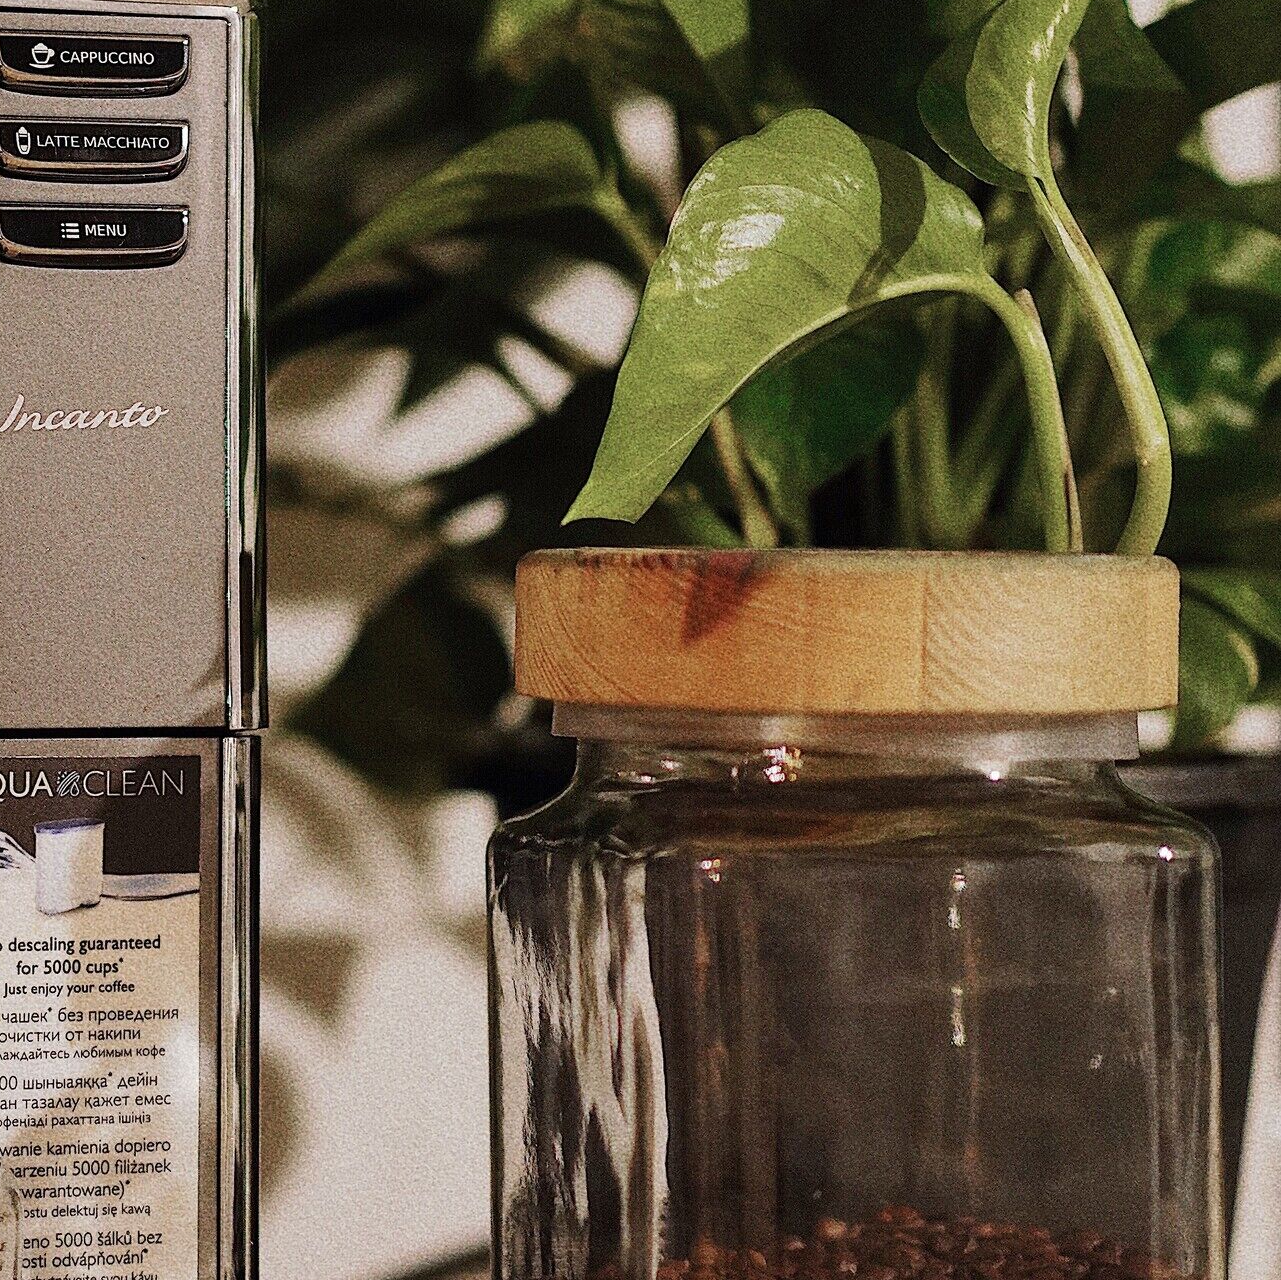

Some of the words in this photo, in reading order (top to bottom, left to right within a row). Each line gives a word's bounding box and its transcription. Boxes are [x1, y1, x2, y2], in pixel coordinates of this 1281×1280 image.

[60, 50, 155, 65] CAPPUCCINO
[36, 135, 79, 148] LATTE
[84, 136, 170, 149] MACCHIATO
[85, 224, 127, 237] MENU
[83, 770, 183, 797] CLEAN
[8, 937, 75, 955] descaling
[79, 935, 161, 954] guaranteed
[17, 961, 38, 974] for
[44, 960, 81, 974] 5000
[3, 983, 27, 998] Just
[31, 983, 63, 997] enjoy
[67, 983, 94, 996] your
[98, 981, 135, 992] coffee
[58, 1007, 83, 1022] без
[89, 1009, 178, 1026] проведения
[65, 1031, 83, 1041] от
[88, 1029, 141, 1040] накипи
[73, 1046, 132, 1058] любимым
[136, 1046, 165, 1059] кофе
[117, 1073, 158, 1088] дейін
[22, 1097, 79, 1111] тазалау
[84, 1096, 129, 1108] қажет
[135, 1093, 171, 1106] емес
[52, 1115, 115, 1128] рахаттана
[47, 1140, 109, 1155] kamienia
[115, 1139, 171, 1157] dopiero
[10, 1162, 67, 1178] arzeniu
[72, 1160, 109, 1175] 5000
[115, 1159, 172, 1174] filiżanek
[19, 1179, 131, 1199] warantowane)
[52, 1205, 98, 1218] delektuj
[102, 1204, 118, 1217] się
[121, 1203, 150, 1216] kawą
[55, 1233, 92, 1248] 5000
[98, 1231, 132, 1246] šálků
[137, 1231, 162, 1244] bez
